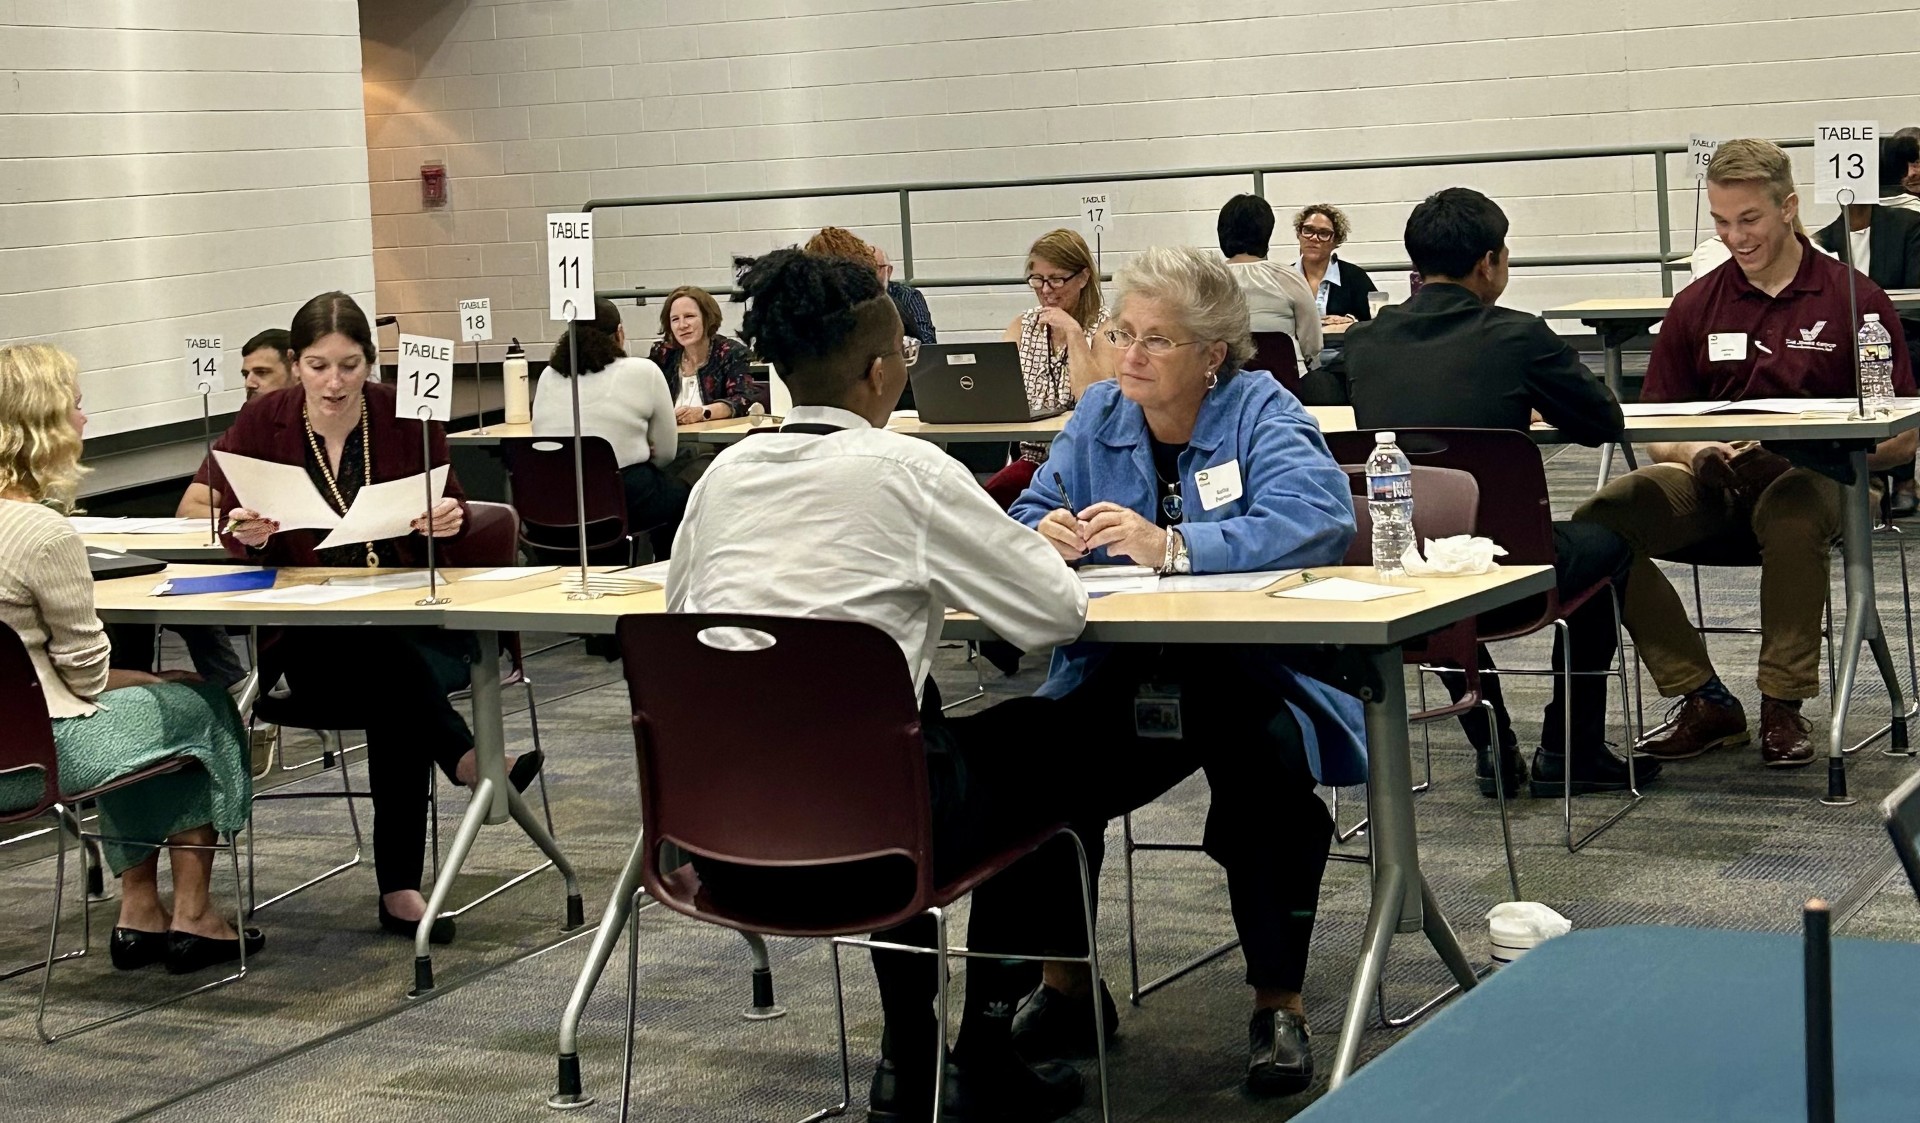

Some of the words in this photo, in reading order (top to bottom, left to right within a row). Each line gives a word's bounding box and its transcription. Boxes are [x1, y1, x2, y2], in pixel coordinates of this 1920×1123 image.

[1818, 127, 1873, 140] TABLE
[1694, 152, 1711, 165] 19
[1829, 153, 1864, 179] 13
[1087, 208, 1103, 221] 17
[549, 222, 589, 239] TABLE
[558, 256, 579, 288] 11
[461, 300, 488, 309] TABLE
[465, 315, 485, 329] 18
[185, 338, 221, 348] TABLE
[402, 341, 449, 361] TABLE
[192, 357, 216, 376] 14
[409, 370, 440, 399] 12
